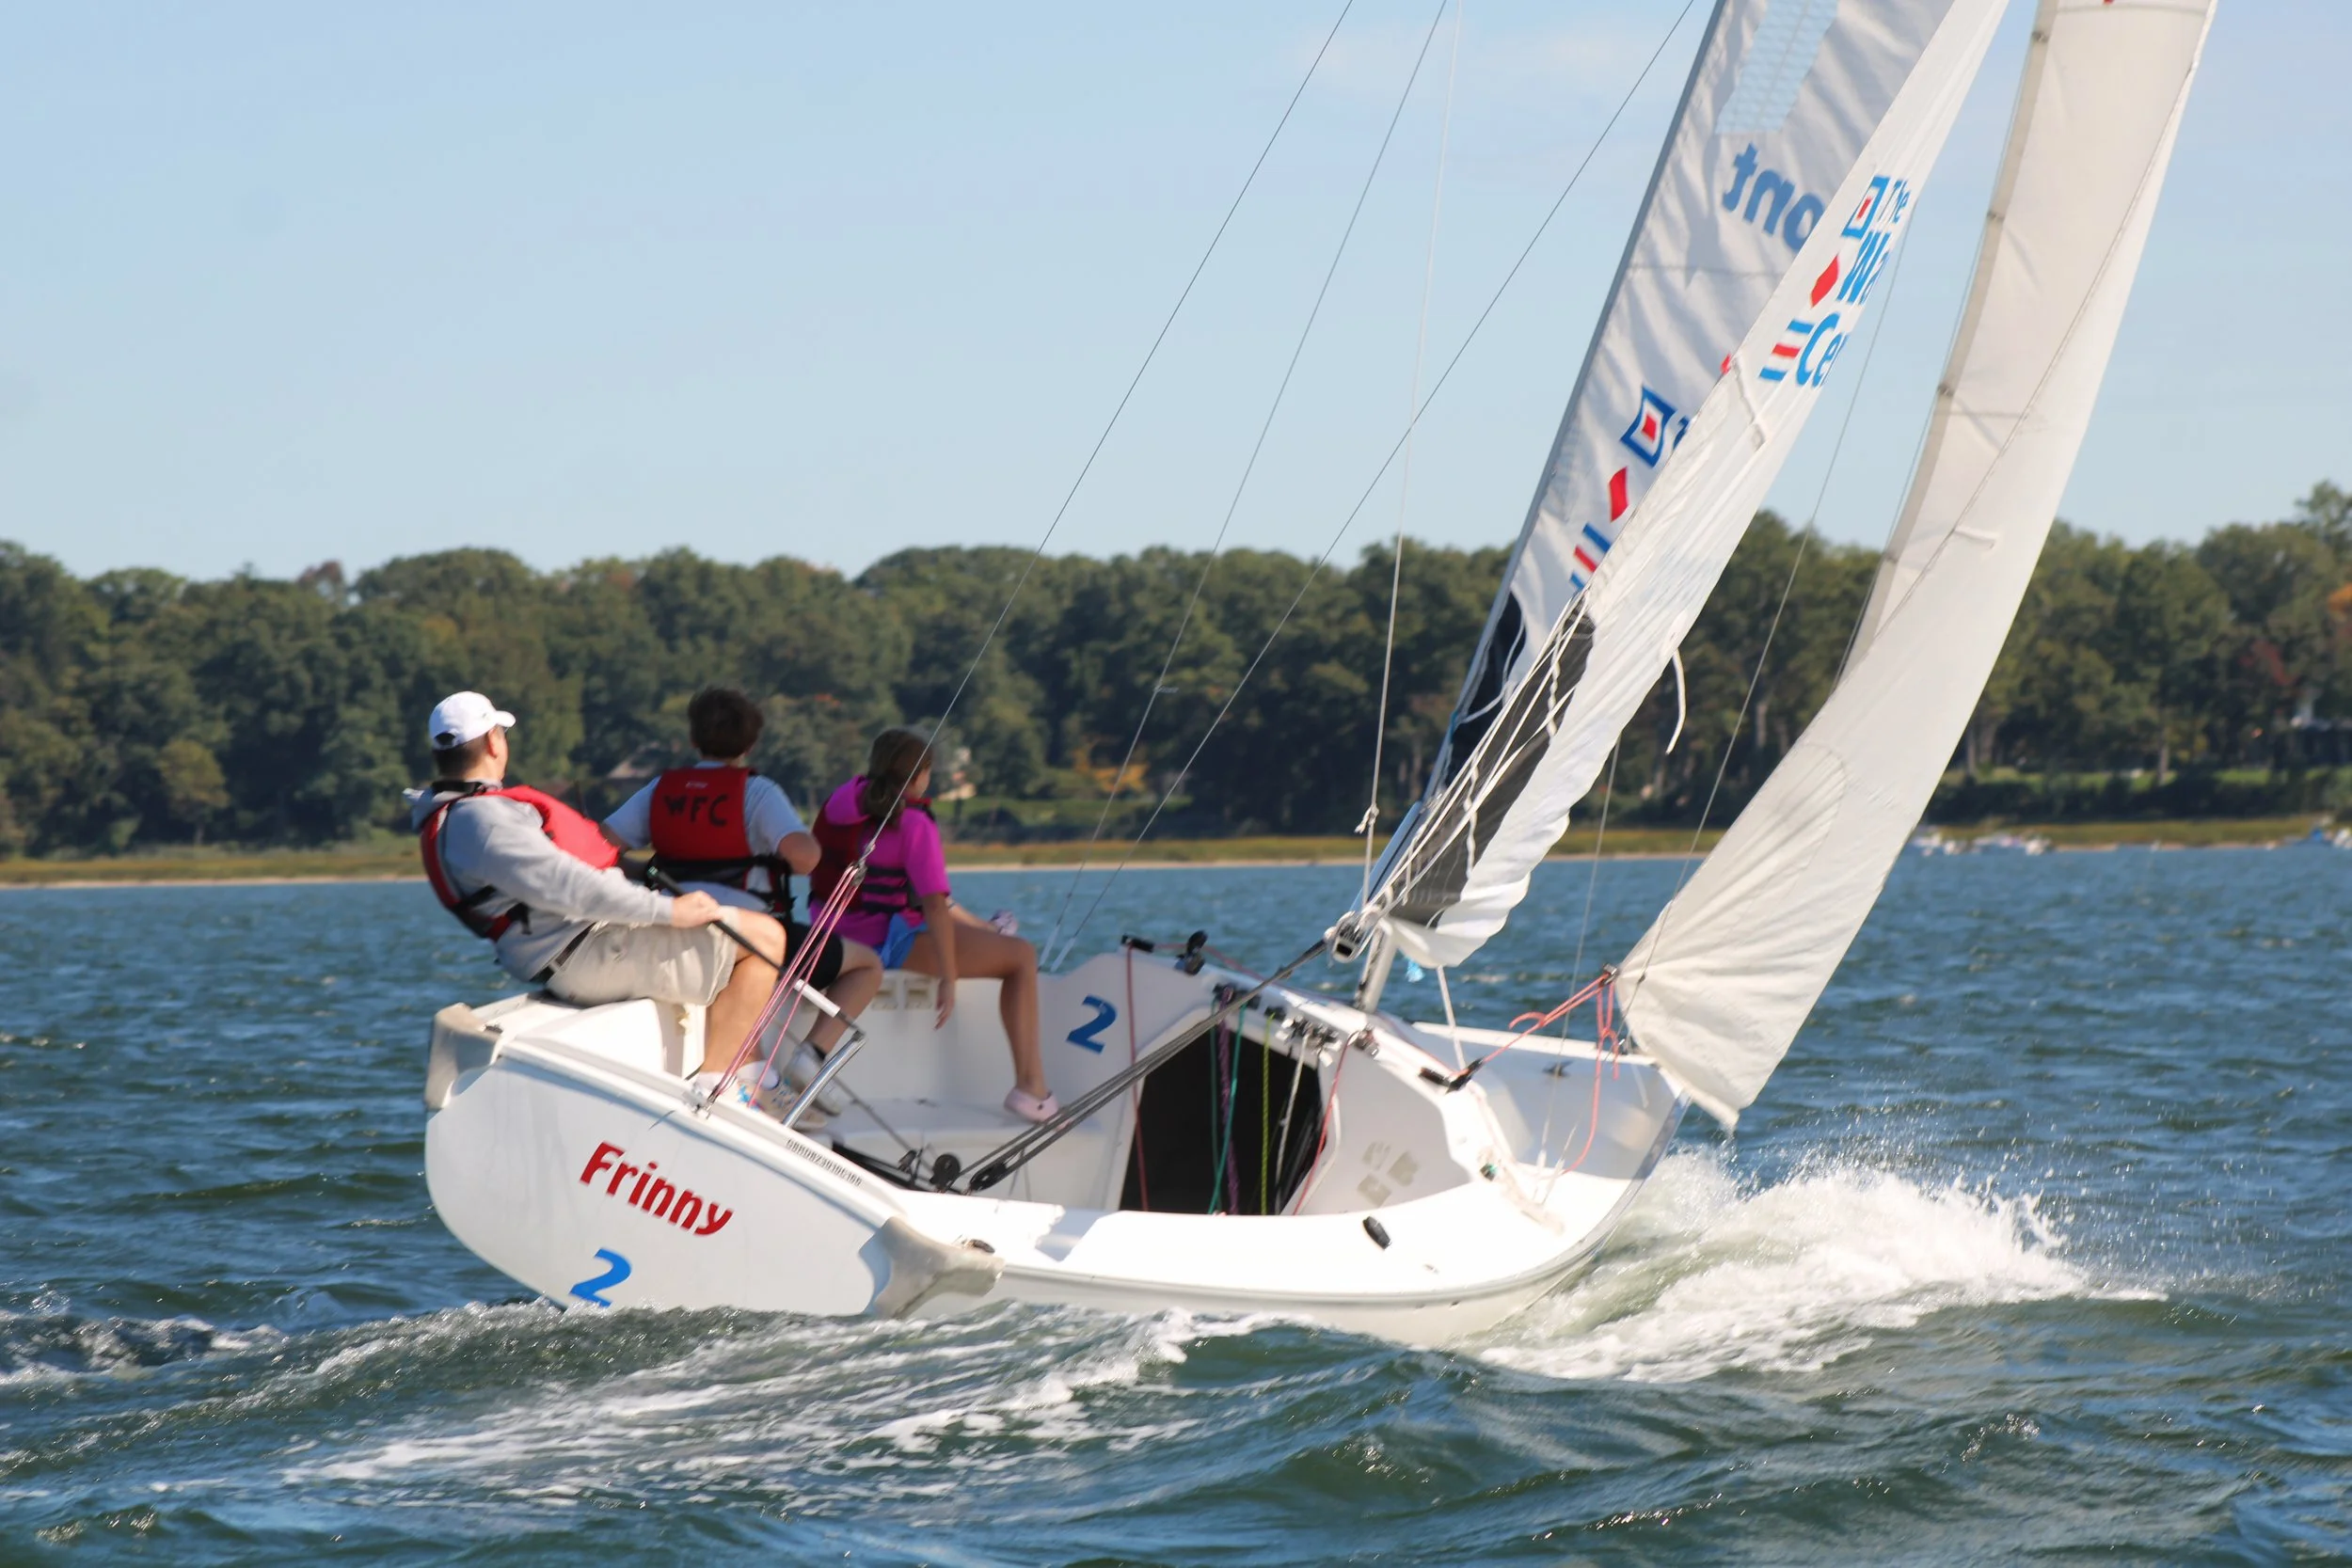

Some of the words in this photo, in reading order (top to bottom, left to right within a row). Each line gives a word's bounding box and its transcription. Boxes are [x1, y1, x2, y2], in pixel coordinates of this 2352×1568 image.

[1877, 179, 1911, 224] The
[663, 794, 728, 827] WFC
[1065, 994, 1117, 1054] 2
[579, 1140, 734, 1236] Frinny
[568, 1247, 631, 1307] 2
